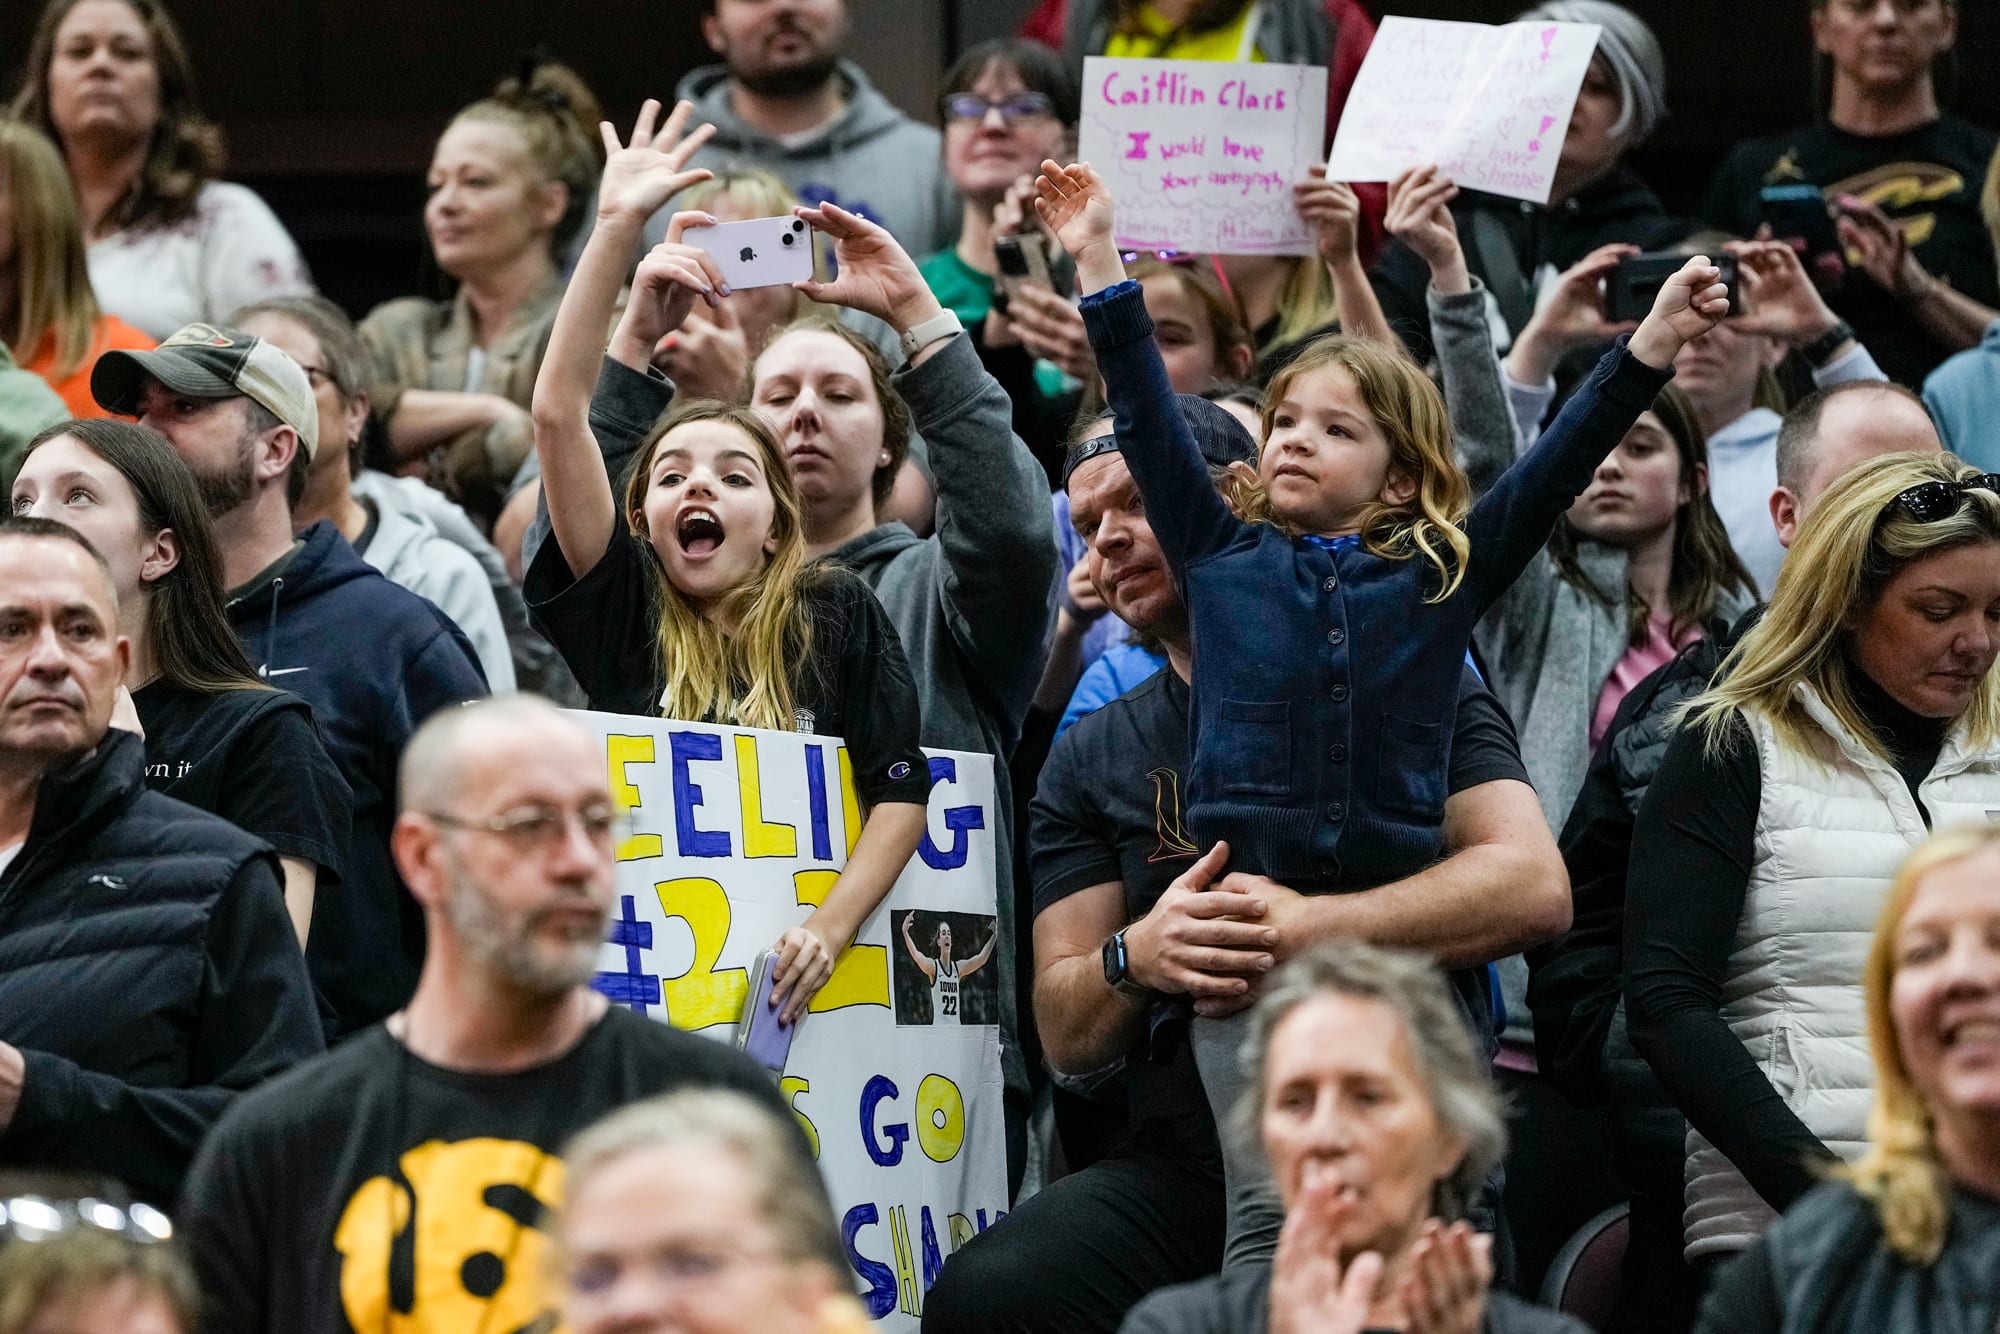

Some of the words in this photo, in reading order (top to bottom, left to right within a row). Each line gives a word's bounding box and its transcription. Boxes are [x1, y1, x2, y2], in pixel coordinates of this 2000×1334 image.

[1102, 70, 1206, 107] Caitlin
[1217, 79, 1286, 111] Clark
[1125, 131, 1151, 160] I
[1222, 134, 1264, 162] love
[176, 760, 192, 778] it
[940, 981, 957, 993] IOWA
[942, 995, 957, 1015] 22
[860, 1073, 965, 1167] GO
